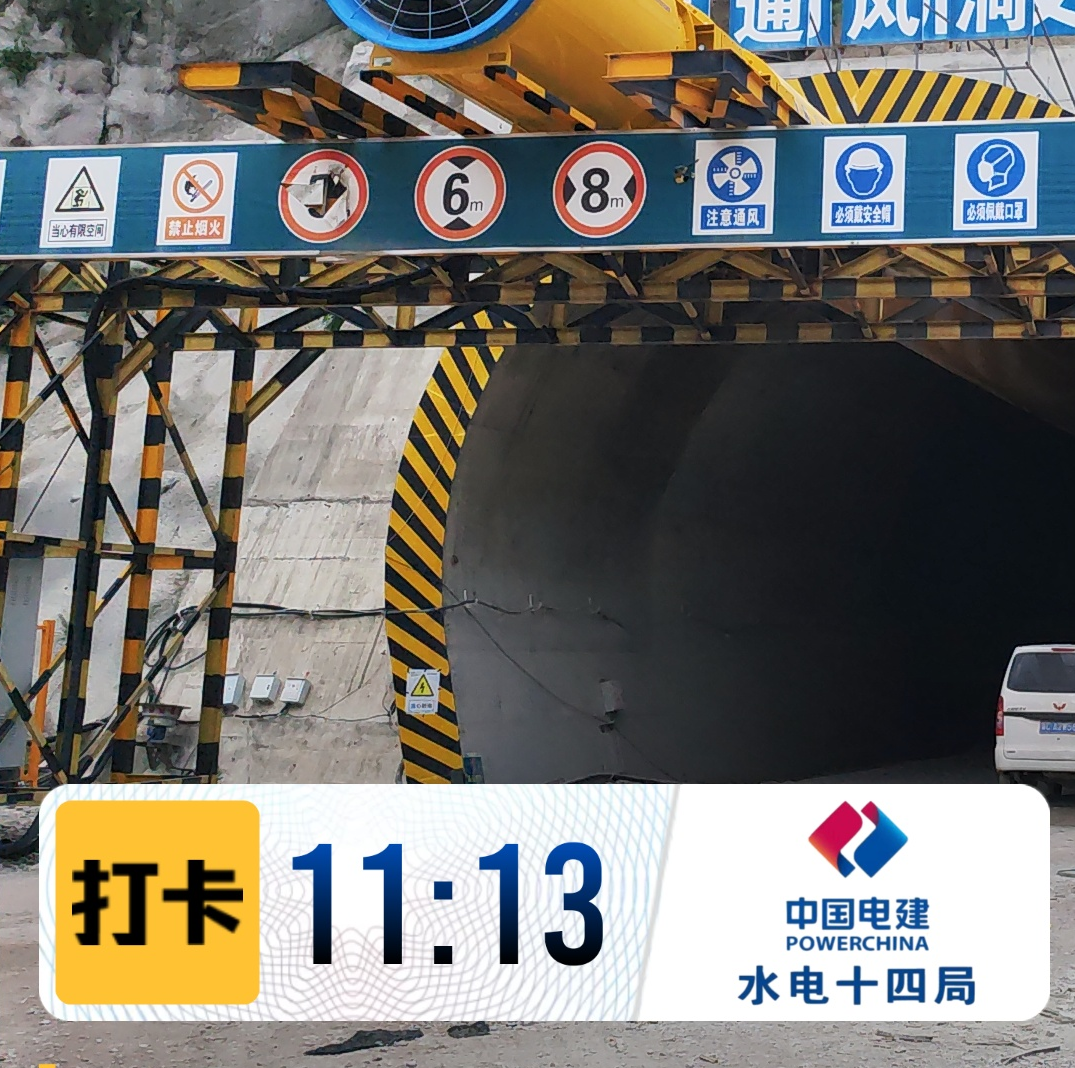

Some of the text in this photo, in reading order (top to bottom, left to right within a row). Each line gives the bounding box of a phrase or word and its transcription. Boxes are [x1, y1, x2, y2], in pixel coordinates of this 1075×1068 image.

[705, 207, 761, 228] 注意通风
[835, 204, 892, 225] 必须戴安全帽
[966, 201, 1024, 222] 必须佩戴口罩
[51, 223, 104, 238] 当心有限空间
[168, 219, 221, 237] 禁止烟火
